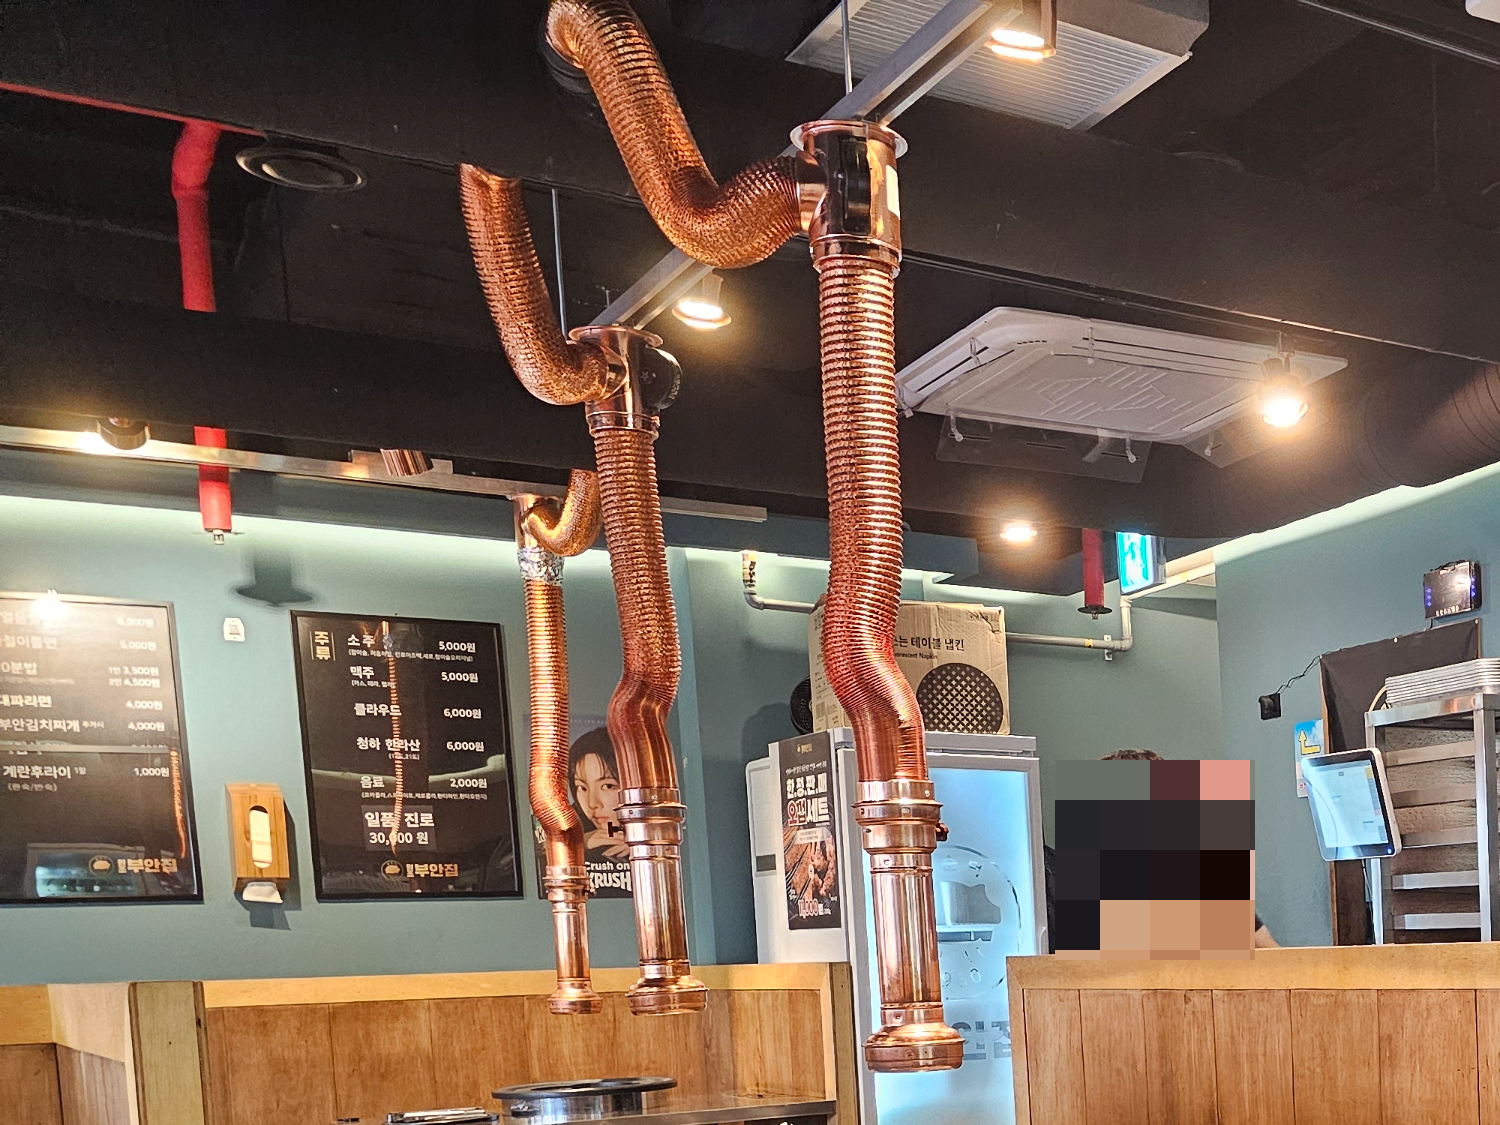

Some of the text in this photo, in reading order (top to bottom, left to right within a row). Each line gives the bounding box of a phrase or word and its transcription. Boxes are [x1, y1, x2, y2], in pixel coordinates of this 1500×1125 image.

[438, 641, 476, 653] 5,000원
[910, 636, 942, 650] 테이블
[944, 638, 965, 652] 냅킨
[350, 666, 479, 683] 맥주 5,000원
[354, 703, 482, 720] 클라우드 6,000원
[356, 737, 485, 752] 청하 한라산 6,000원
[3, 765, 72, 779] 계란후라이
[133, 767, 170, 778] 1,000원
[360, 776, 488, 789] 음료 2,000원
[364, 812, 435, 828] 일품 진로
[369, 831, 429, 846] 30,000 원
[414, 863, 459, 877] 부안집
[585, 861, 631, 871] Crush on
